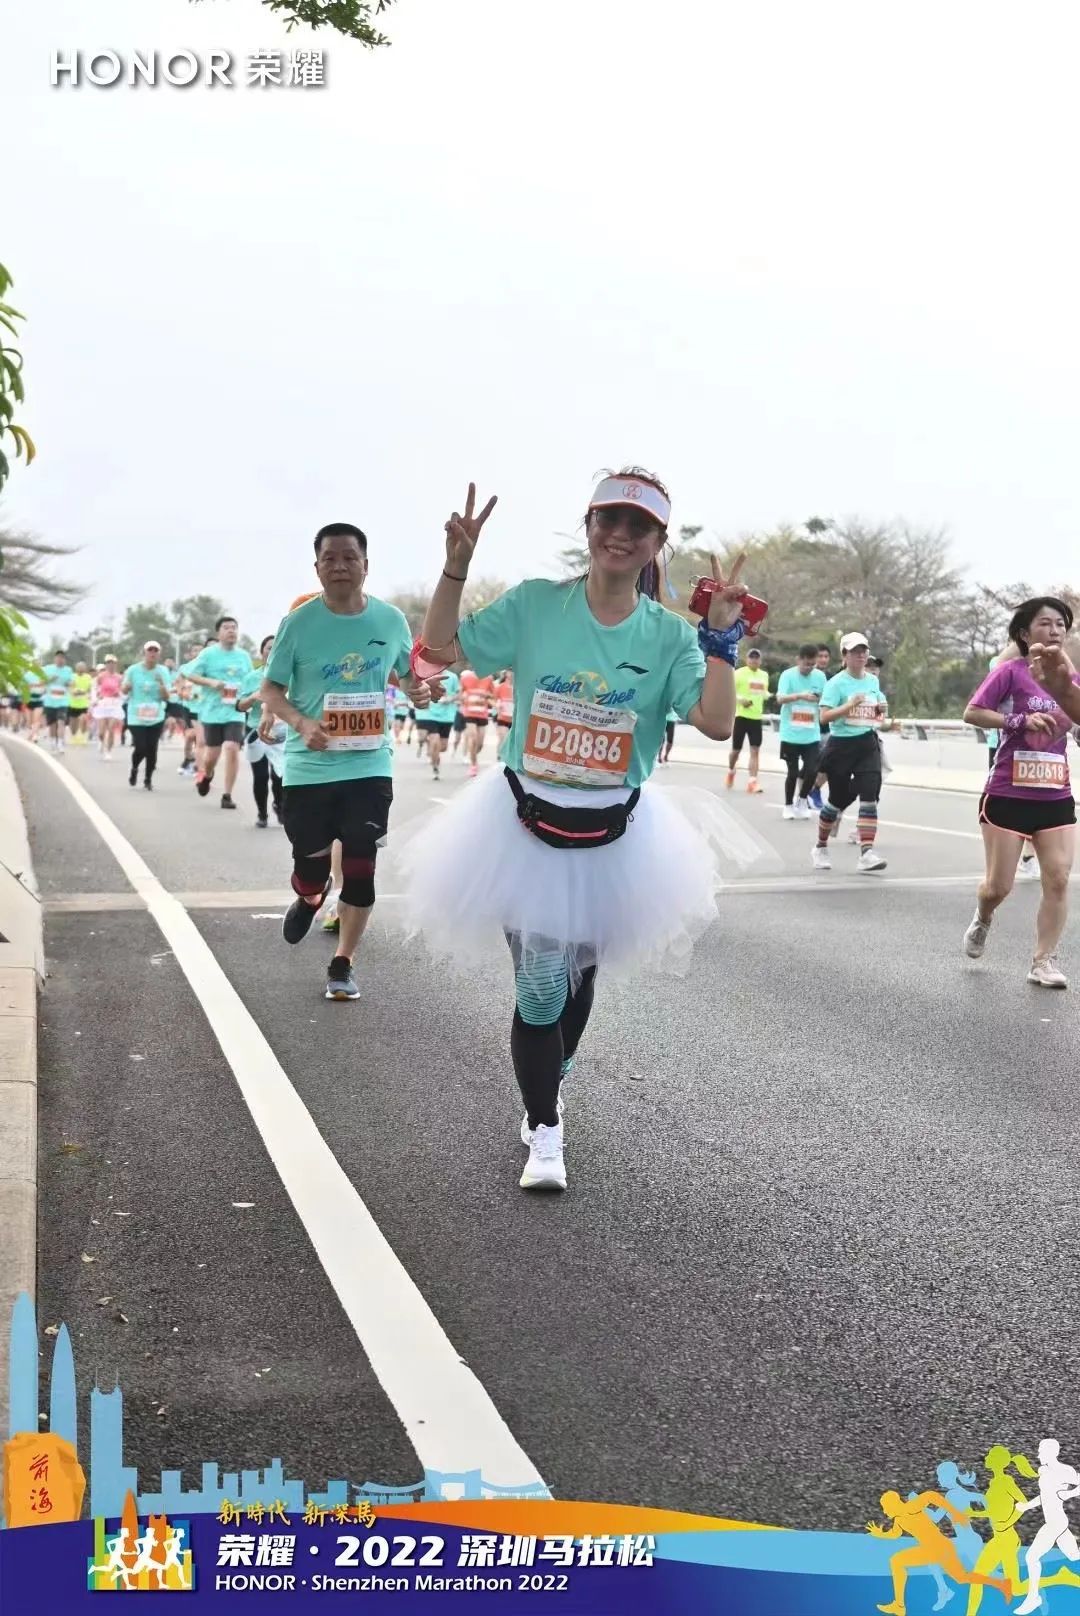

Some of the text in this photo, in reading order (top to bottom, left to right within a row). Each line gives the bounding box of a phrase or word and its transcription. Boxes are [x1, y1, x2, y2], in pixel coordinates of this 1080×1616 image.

[328, 711, 382, 731] D10616
[533, 721, 622, 763] D20886
[1018, 762, 1064, 780] D20618
